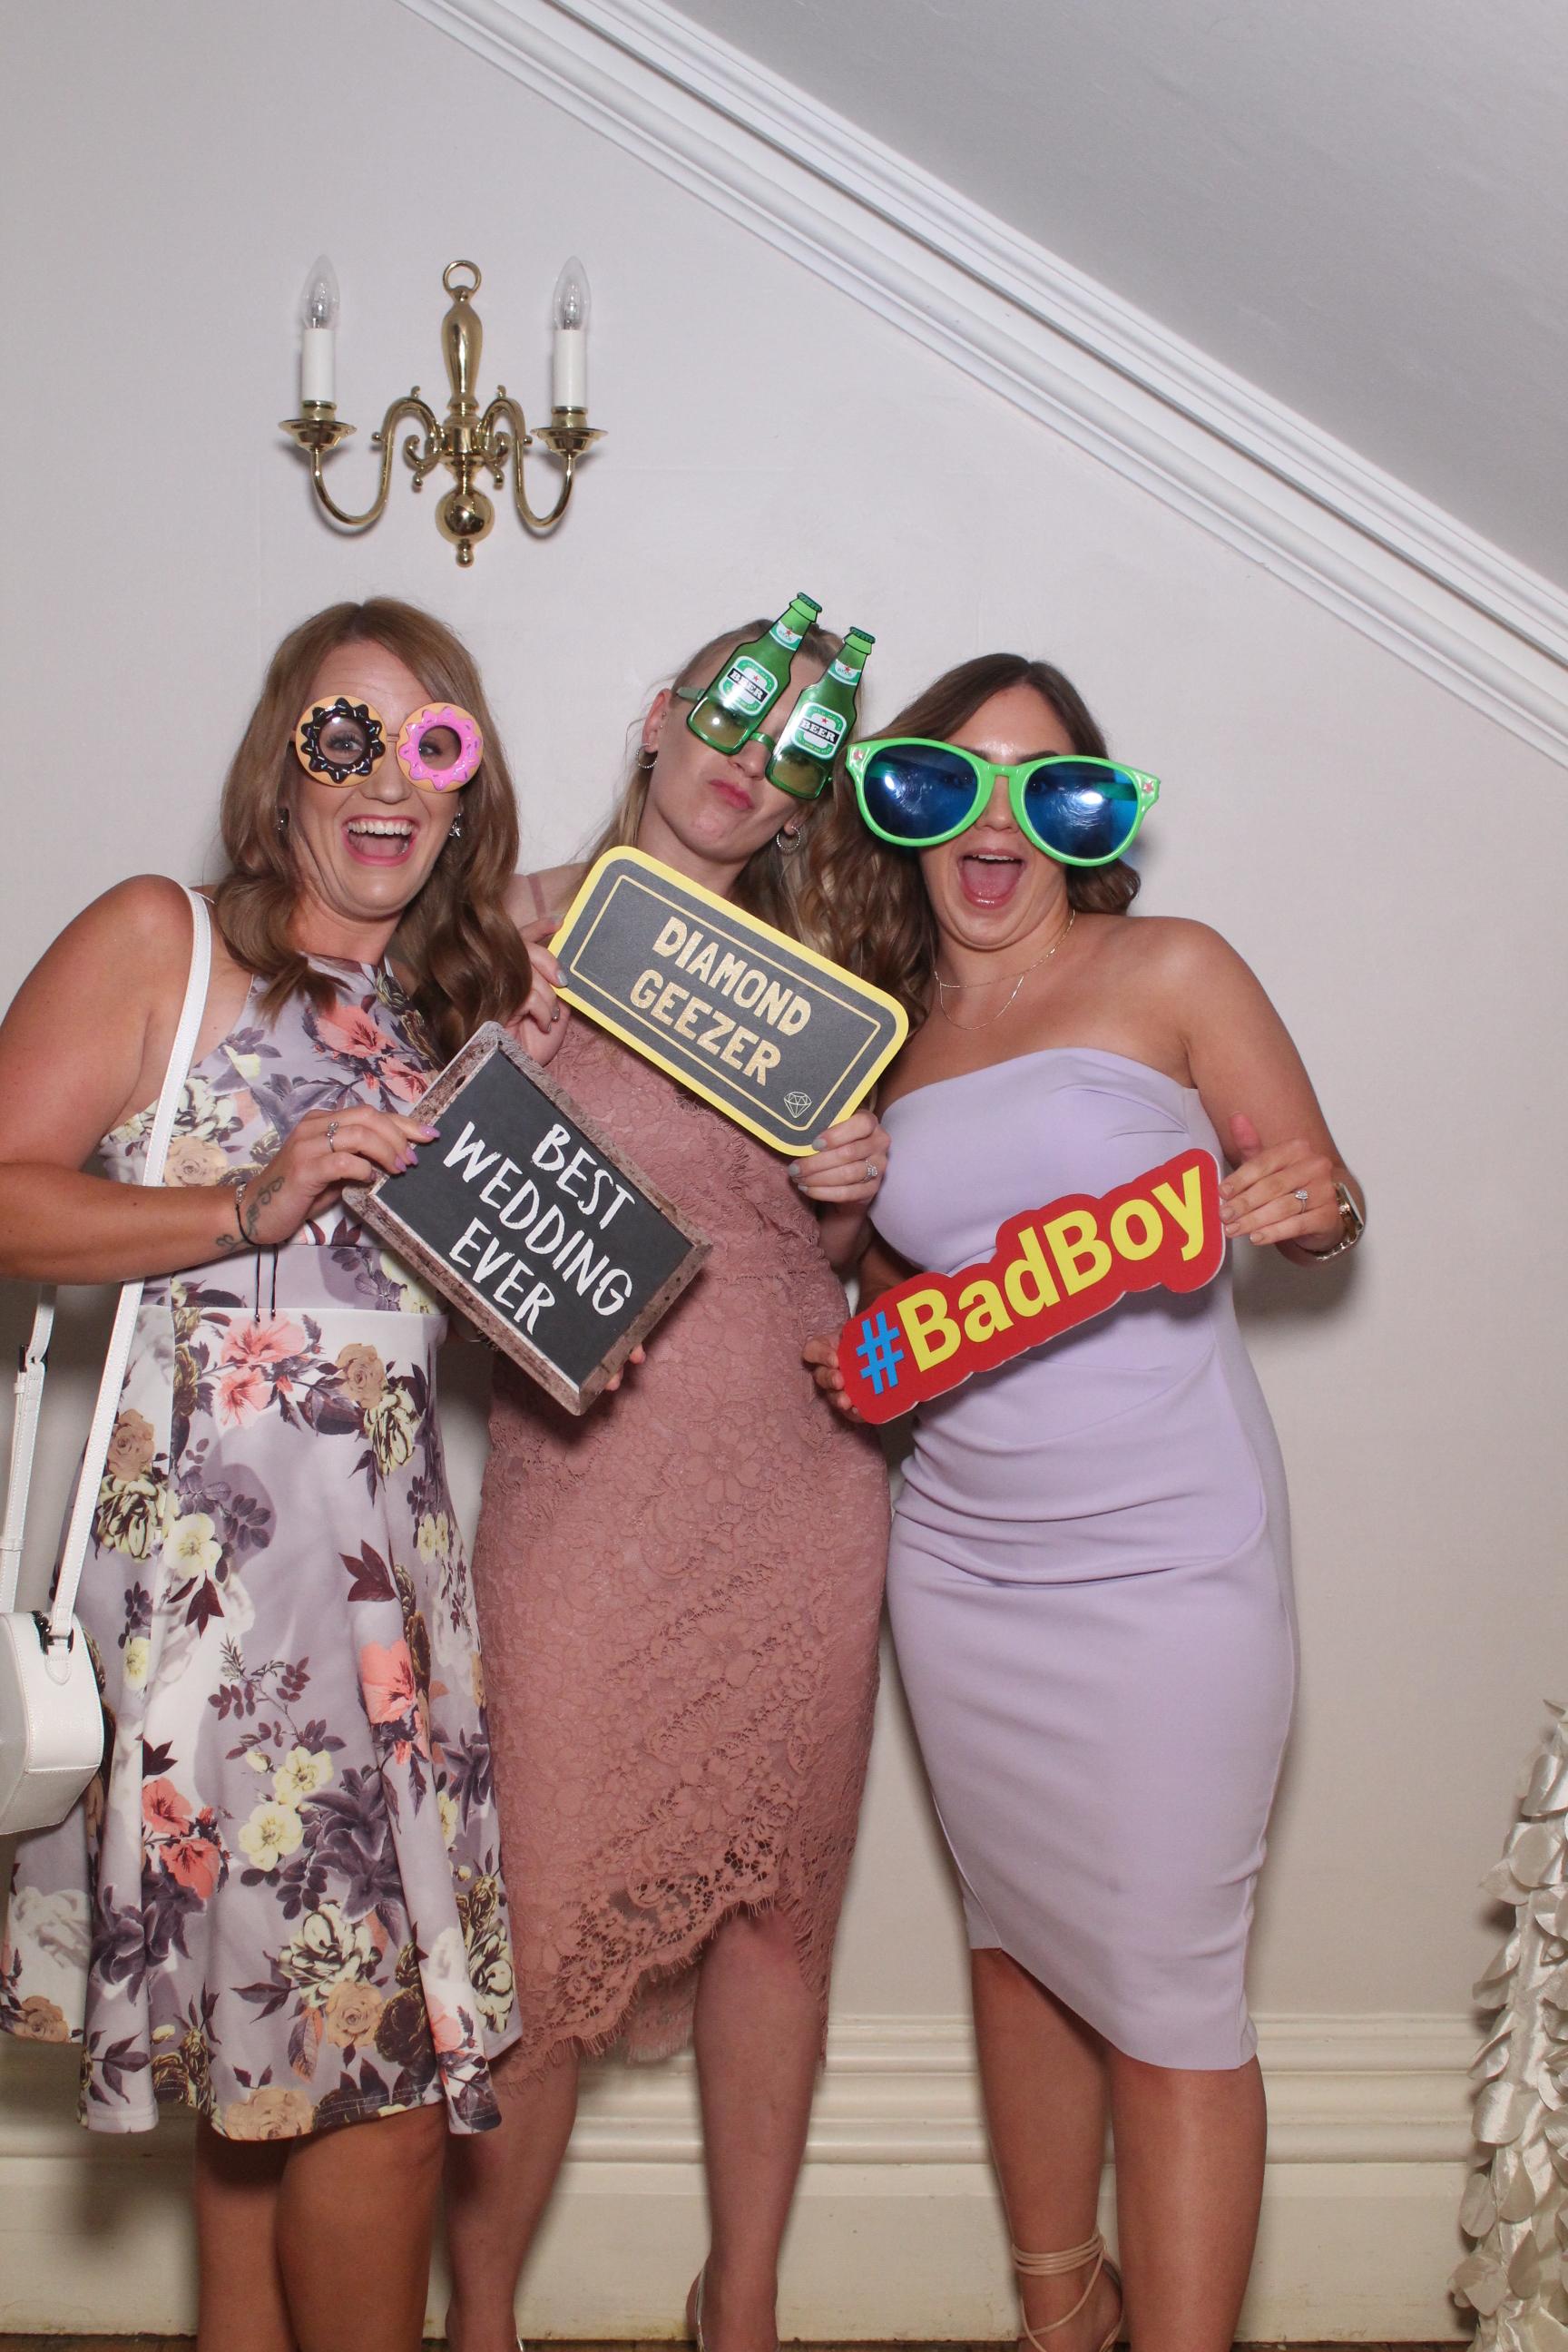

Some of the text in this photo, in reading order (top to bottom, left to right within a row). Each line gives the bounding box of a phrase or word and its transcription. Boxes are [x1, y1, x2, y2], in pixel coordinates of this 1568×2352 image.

[730, 670, 764, 700] BEER
[800, 719, 836, 742] BEER
[630, 969, 781, 1086] GEEZER
[652, 916, 811, 1036] DIAMOND
[443, 1121, 632, 1316] WEDDING
[531, 1123, 635, 1230] BEST
[449, 1217, 555, 1336] EVER
[856, 1165, 1204, 1395] #BadBoy
